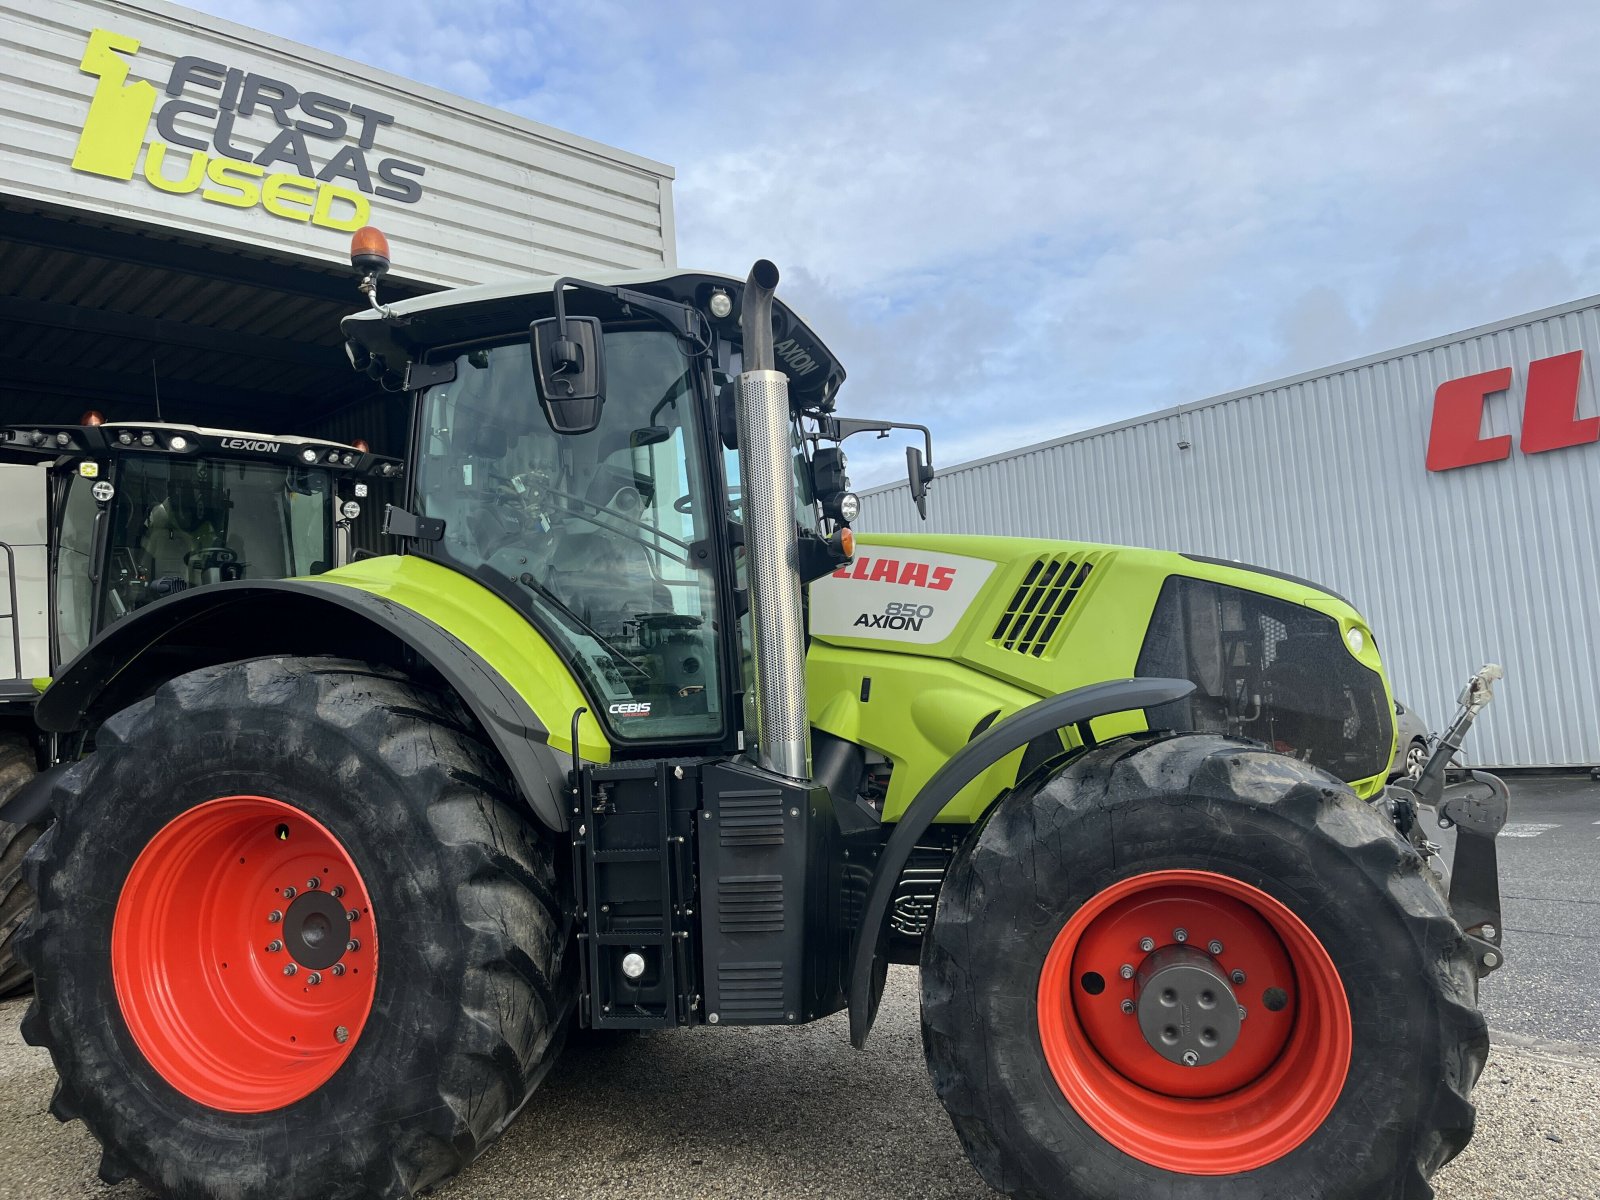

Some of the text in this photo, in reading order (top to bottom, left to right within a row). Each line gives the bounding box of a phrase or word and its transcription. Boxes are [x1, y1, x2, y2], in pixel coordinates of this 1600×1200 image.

[166, 56, 395, 149] FIRST
[157, 100, 425, 203] CLAAS
[144, 141, 371, 232] USED
[774, 338, 820, 376] AXION
[1425, 349, 1600, 472] CL
[220, 438, 280, 453] LEXION
[853, 613, 924, 632] AXION
[885, 602, 934, 619] 850
[609, 702, 652, 714] CEBIS
